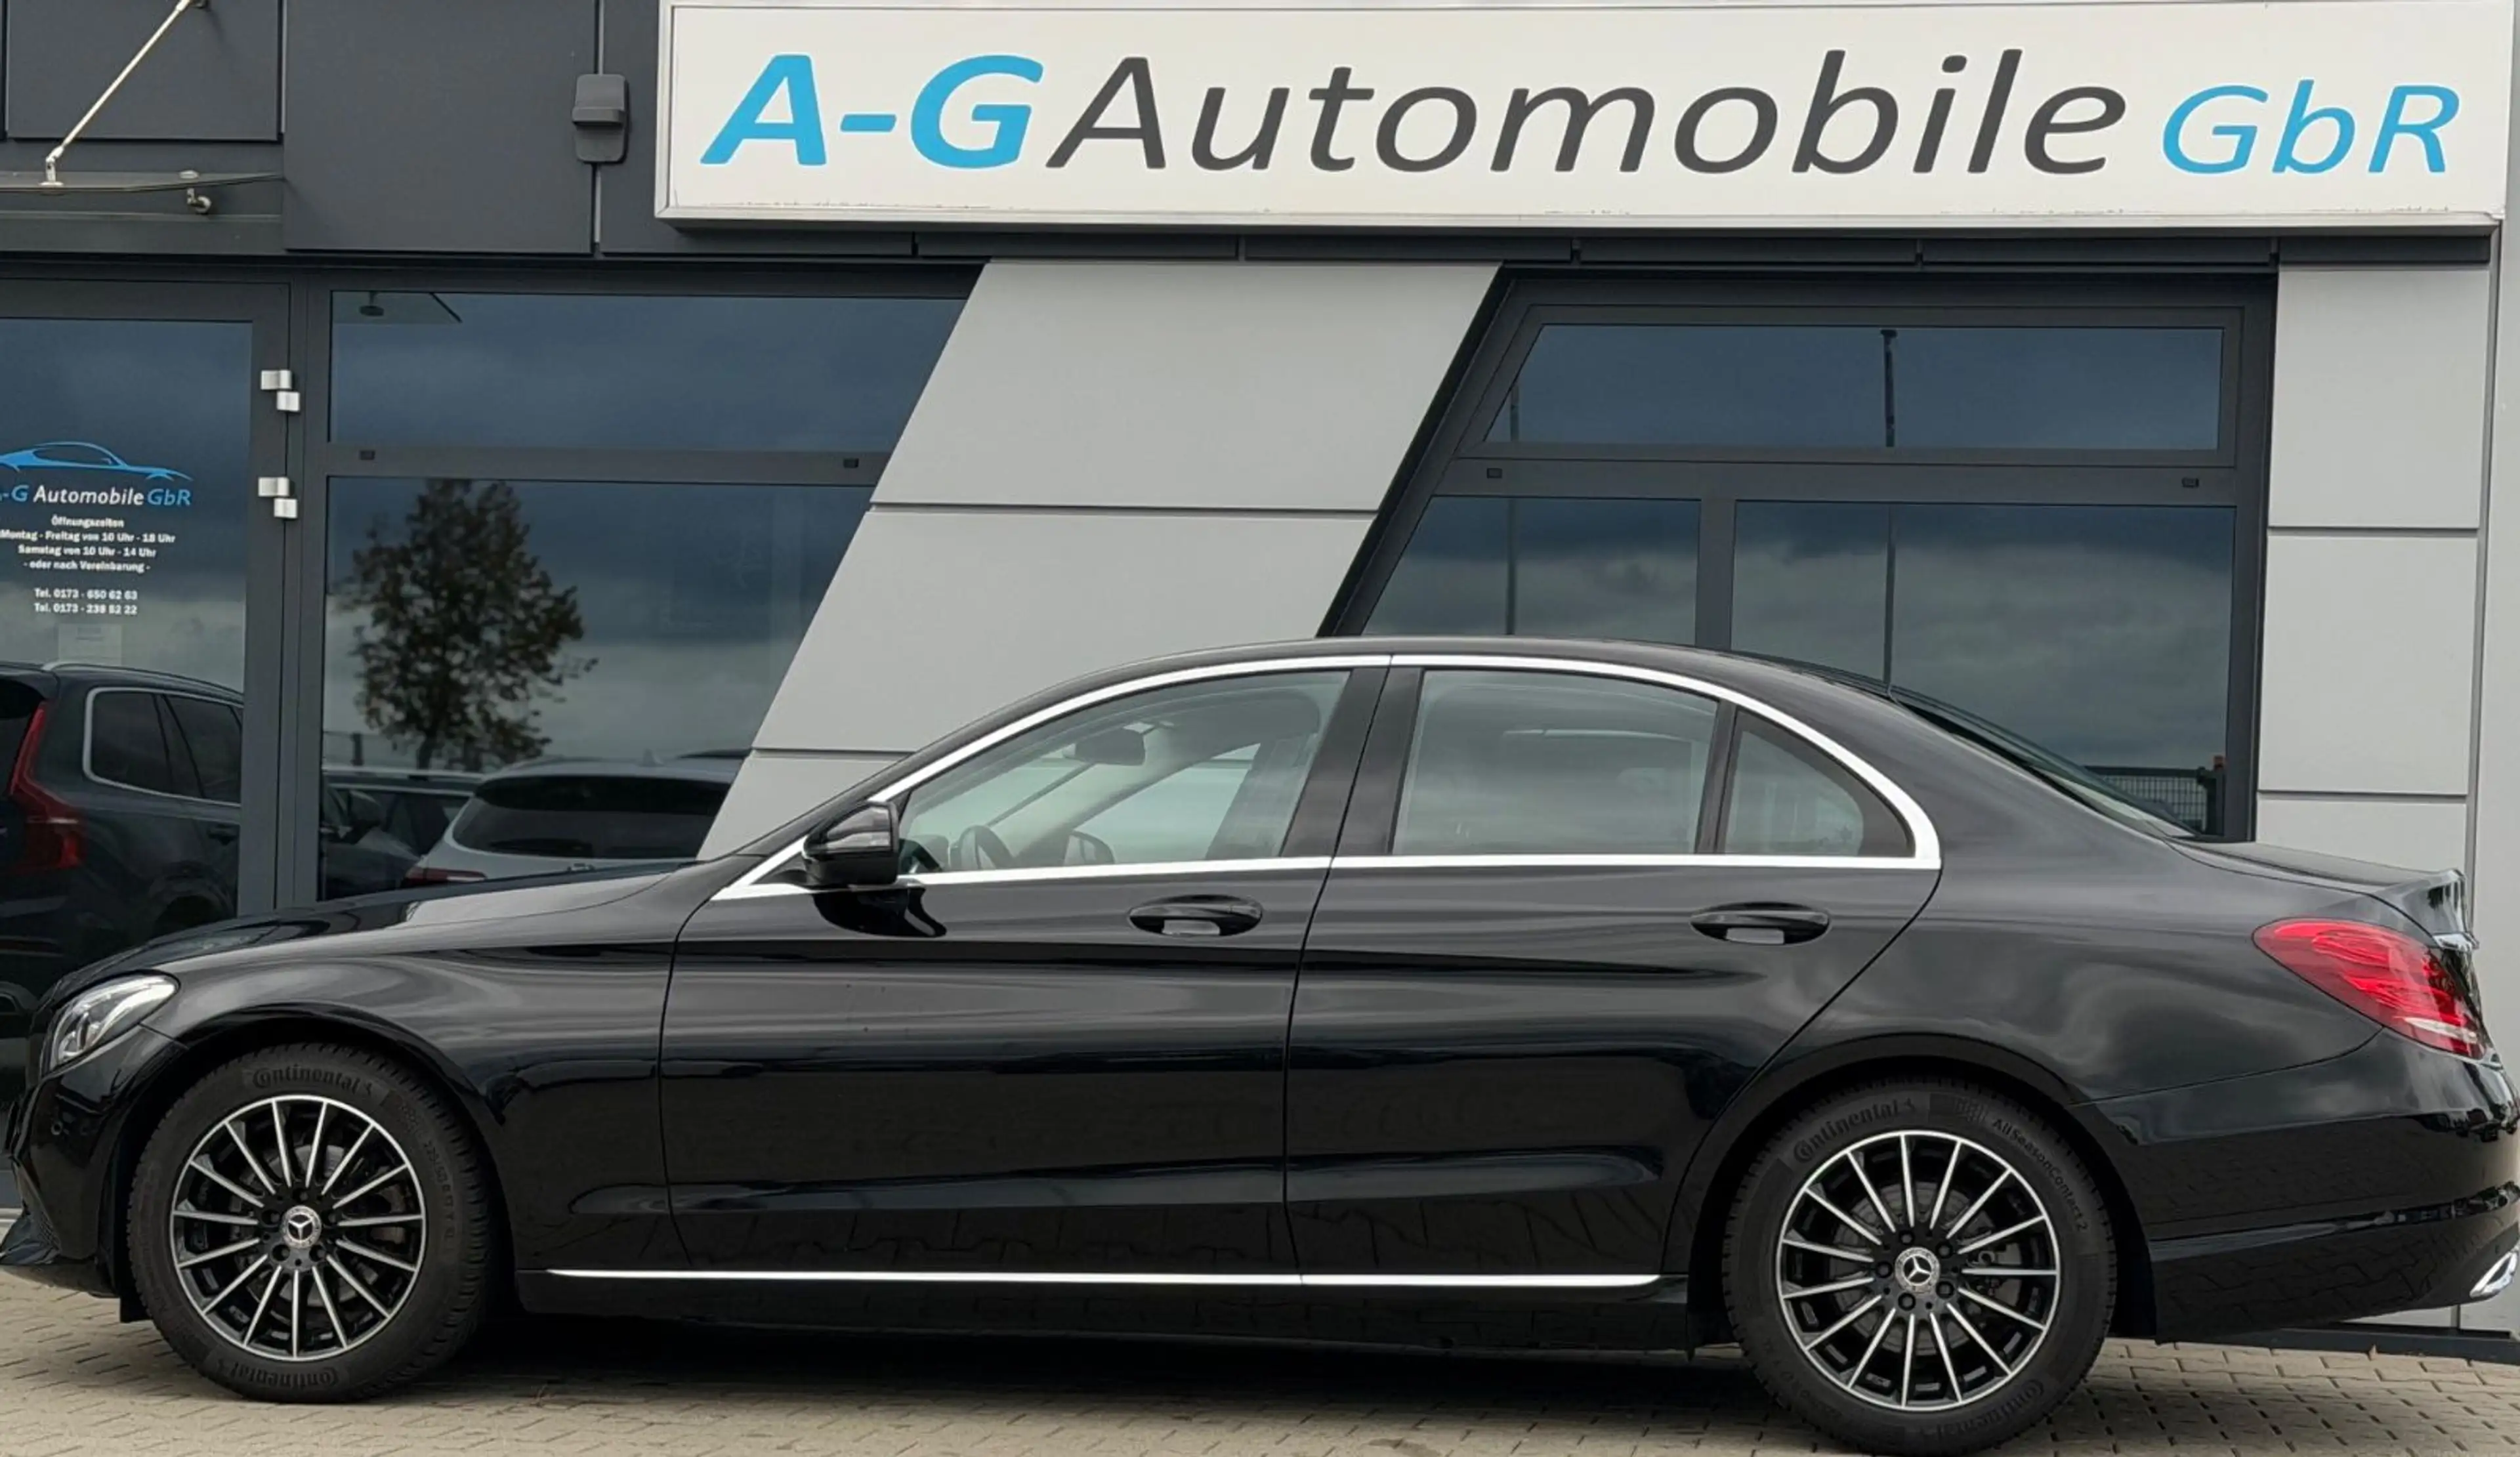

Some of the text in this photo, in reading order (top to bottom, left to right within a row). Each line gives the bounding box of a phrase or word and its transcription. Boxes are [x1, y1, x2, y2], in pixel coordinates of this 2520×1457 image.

[701, 49, 2460, 175] A-G Automobile GbR
[0, 484, 191, 505] -G Automobile GbR
[51, 515, 124, 528] Öffnungszeiten
[45, 531, 80, 542] Freitag
[102, 532, 115, 542] 10
[117, 532, 135, 542] Uhr
[158, 534, 176, 543] Uhr
[18, 544, 61, 557] Samstag
[83, 545, 96, 556] 10
[98, 546, 116, 556] Uhr
[123, 547, 136, 557] 14
[138, 547, 157, 558] Uhr
[30, 559, 51, 569] oder
[53, 560, 78, 570] nach
[79, 560, 145, 574] Vereinbarung
[34, 588, 51, 599] Tel.
[34, 602, 51, 613] Tel.
[252, 1064, 361, 1096] Continental
[1793, 1097, 1899, 1164] Continental
